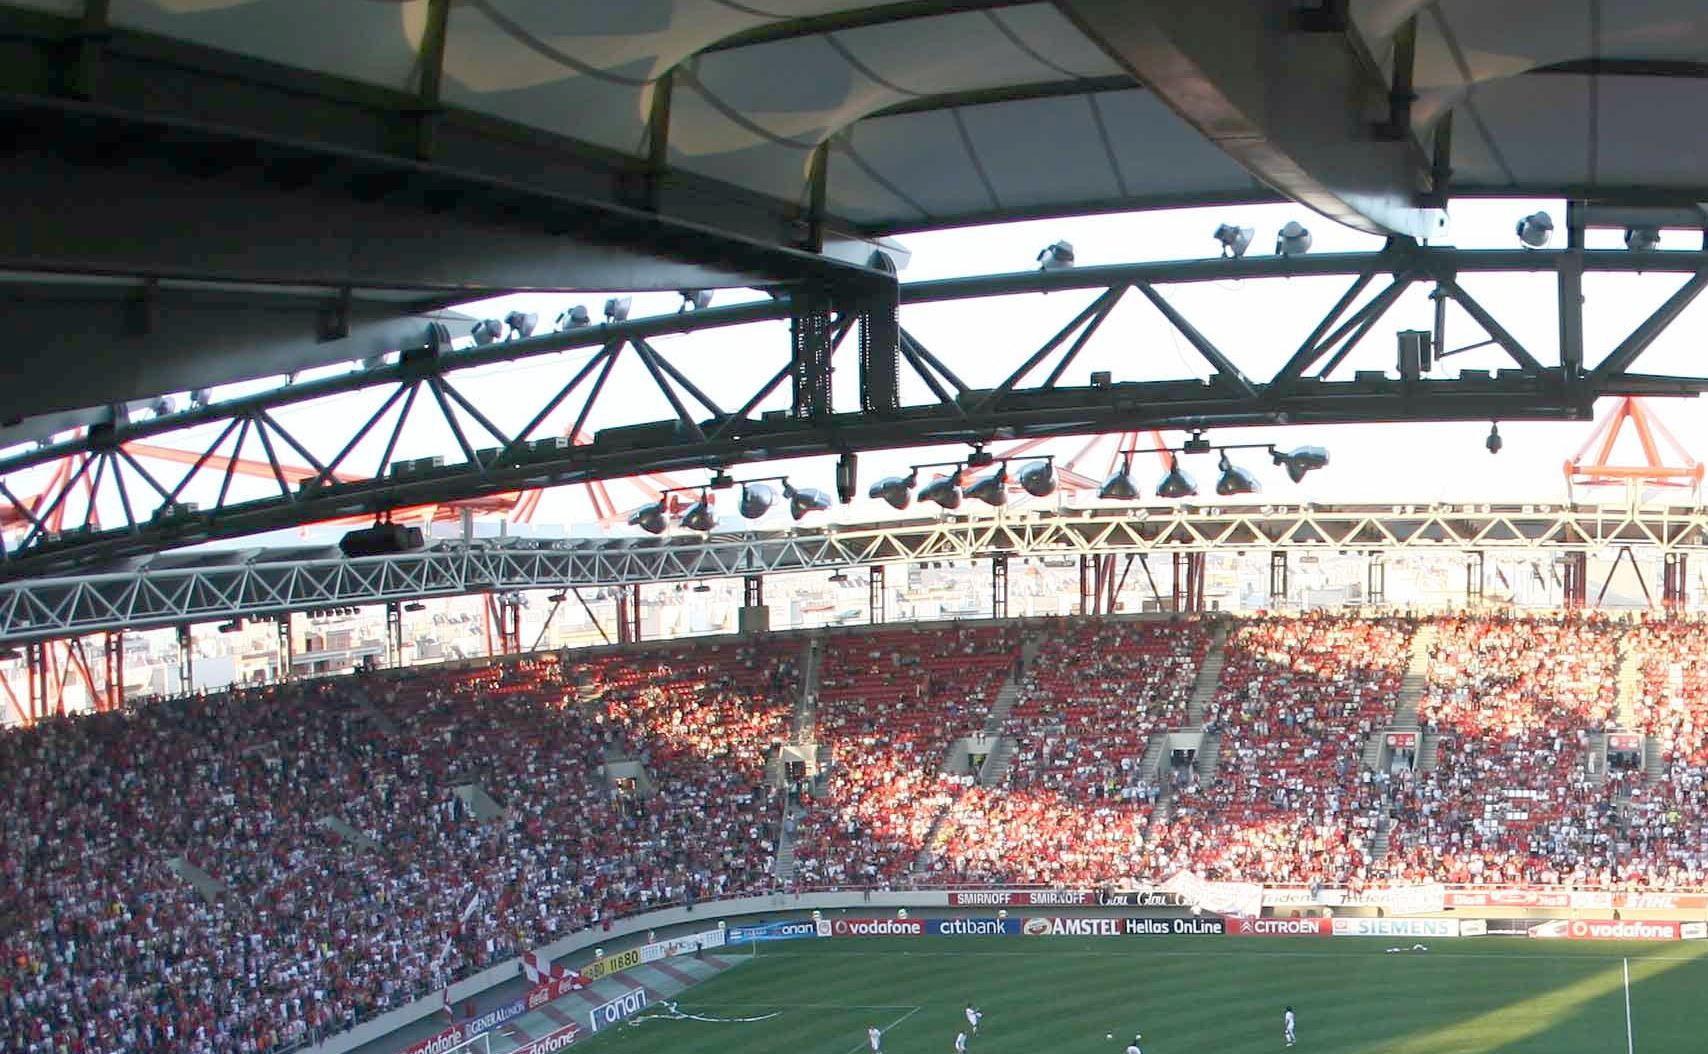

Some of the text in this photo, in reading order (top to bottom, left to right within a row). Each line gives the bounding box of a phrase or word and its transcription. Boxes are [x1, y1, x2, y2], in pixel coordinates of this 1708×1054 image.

[957, 893, 1085, 905] SMIRNOFF SMIRNOFF
[849, 920, 921, 935] vodafone
[939, 918, 1006, 935] citibank
[1052, 918, 1120, 935] AMSTEL
[1126, 919, 1222, 934] Hellas OnLine
[1358, 920, 1449, 935] SIEMENS
[1590, 921, 1674, 938] vodafone
